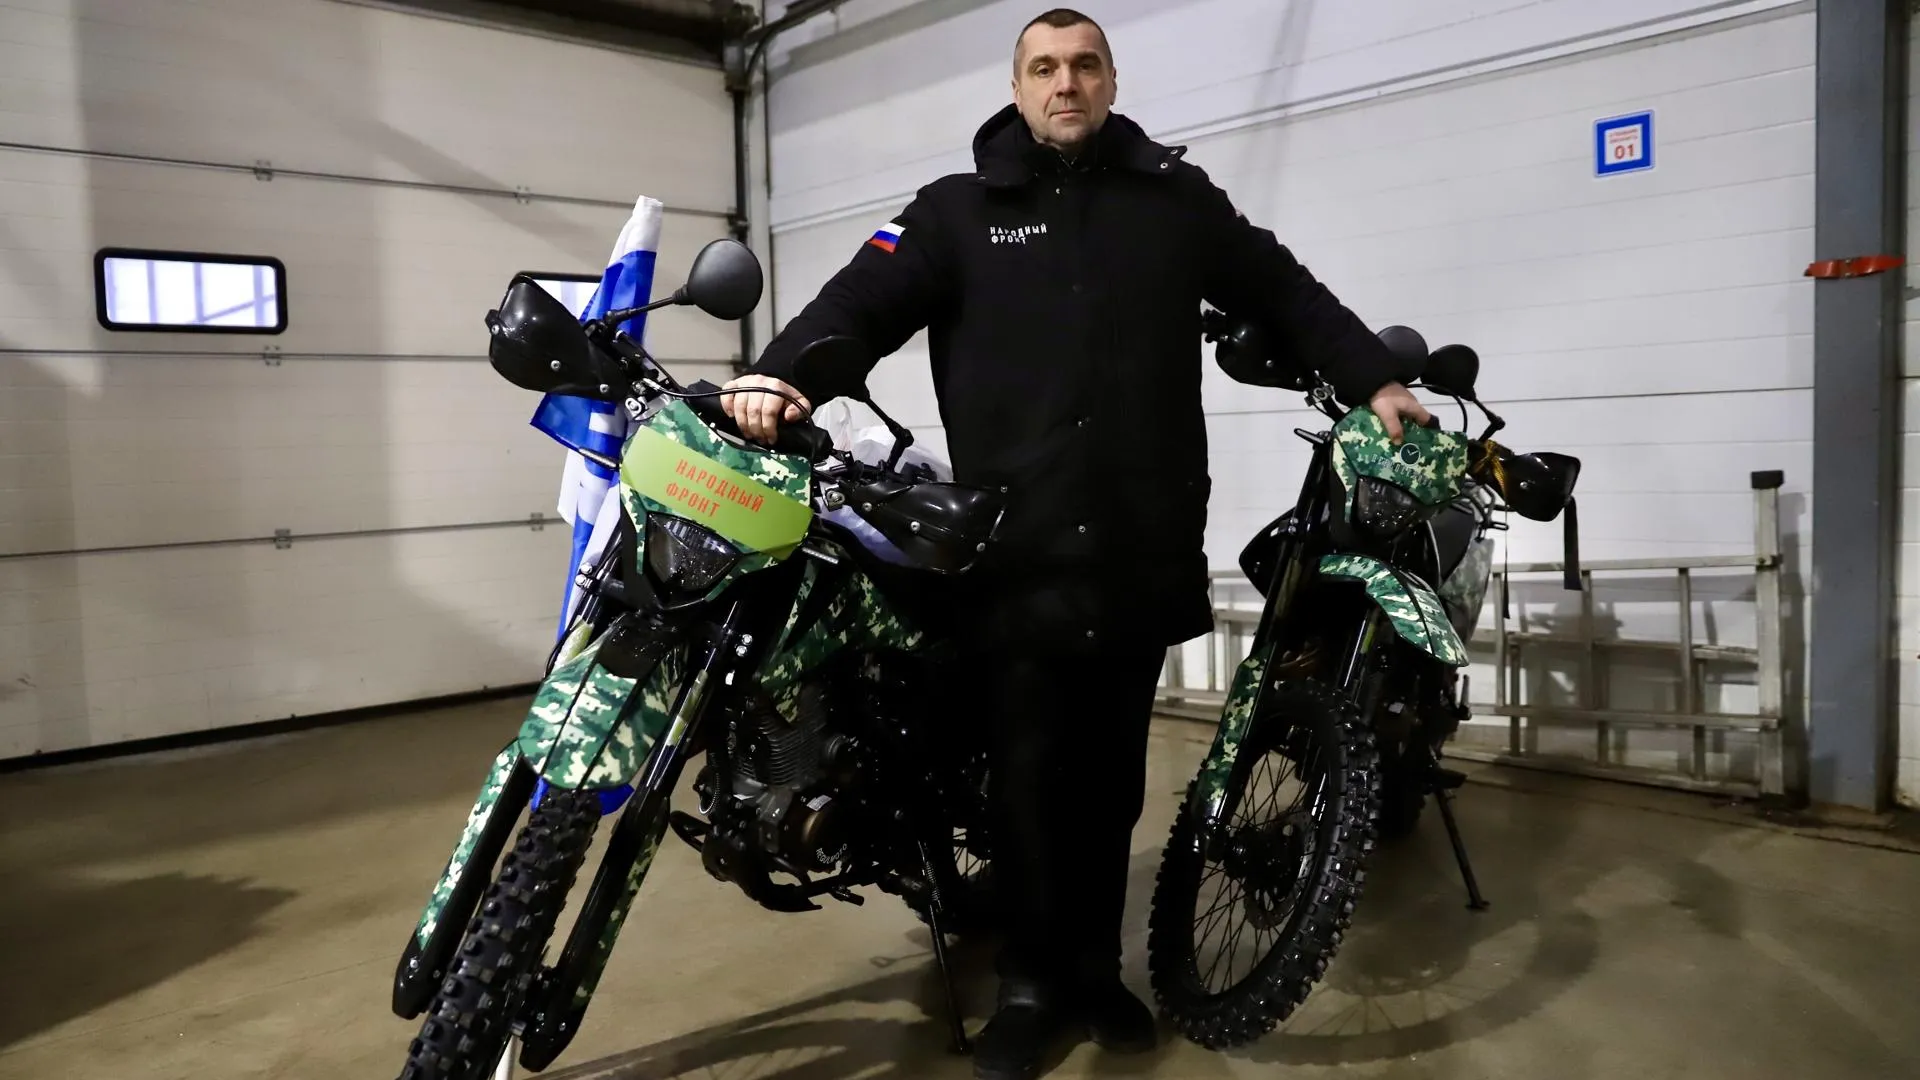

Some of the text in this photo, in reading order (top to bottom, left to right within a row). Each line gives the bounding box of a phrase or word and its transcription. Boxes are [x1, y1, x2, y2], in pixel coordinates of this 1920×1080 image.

[1614, 144, 1634, 160] 01
[666, 482, 721, 517] ФРОНТ
[675, 458, 766, 513] НАРОДНЫЙ
